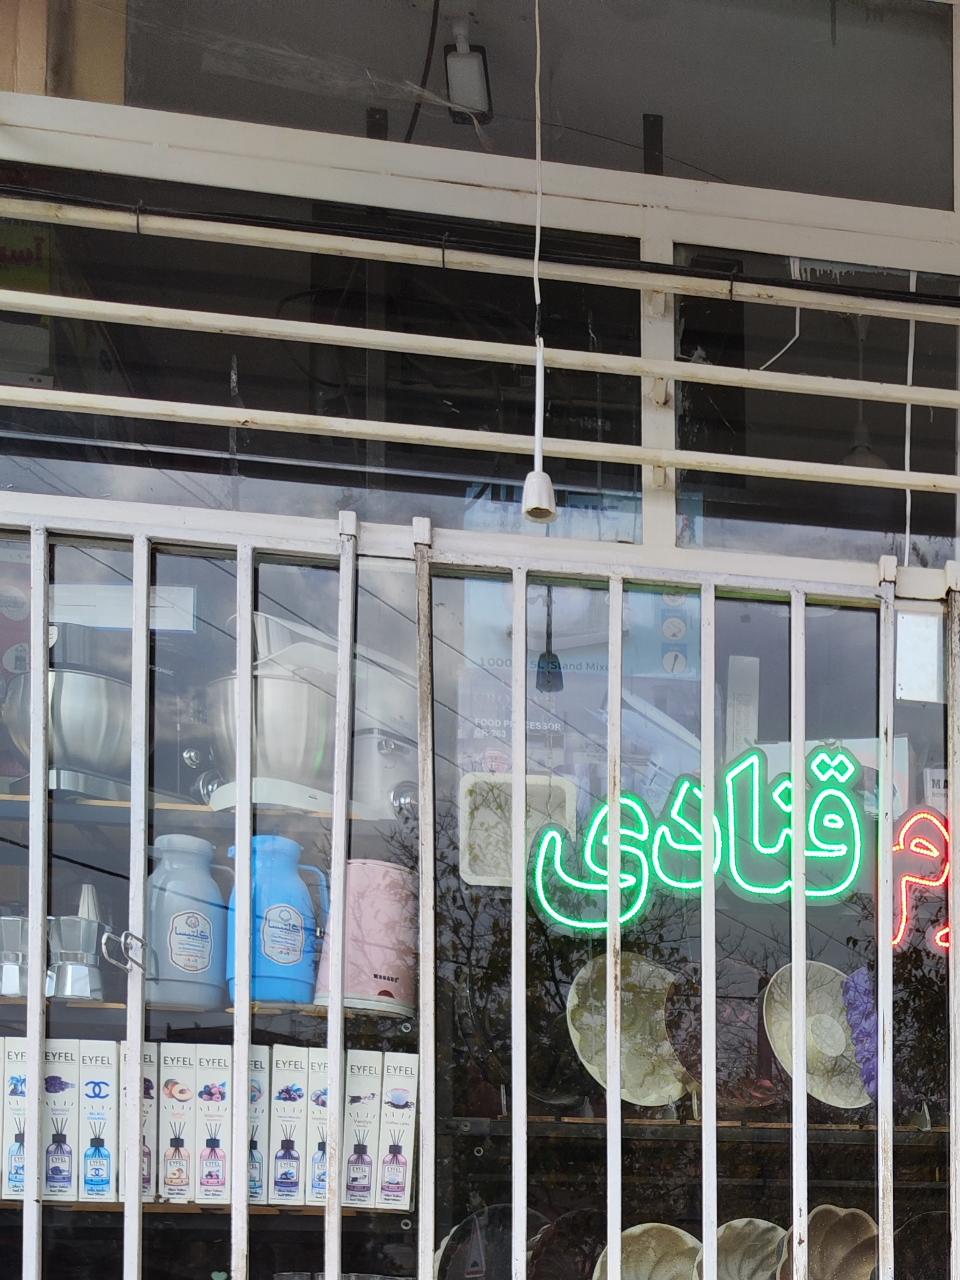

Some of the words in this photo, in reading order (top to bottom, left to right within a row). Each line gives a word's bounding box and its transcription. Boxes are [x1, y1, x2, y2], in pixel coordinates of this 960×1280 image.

[534, 751, 862, 930] قنادی
[7, 1051, 26, 1061] EYF
[44, 1051, 76, 1062] EYFEL
[82, 1055, 112, 1065] EYFEL
[163, 1056, 194, 1067] EYFEL
[199, 1058, 229, 1068] EYFEL
[275, 1059, 305, 1070] EYFEL
[310, 1061, 329, 1071] EYF
[350, 1064, 379, 1075] EYFEL
[386, 1064, 415, 1076] EYFEL
